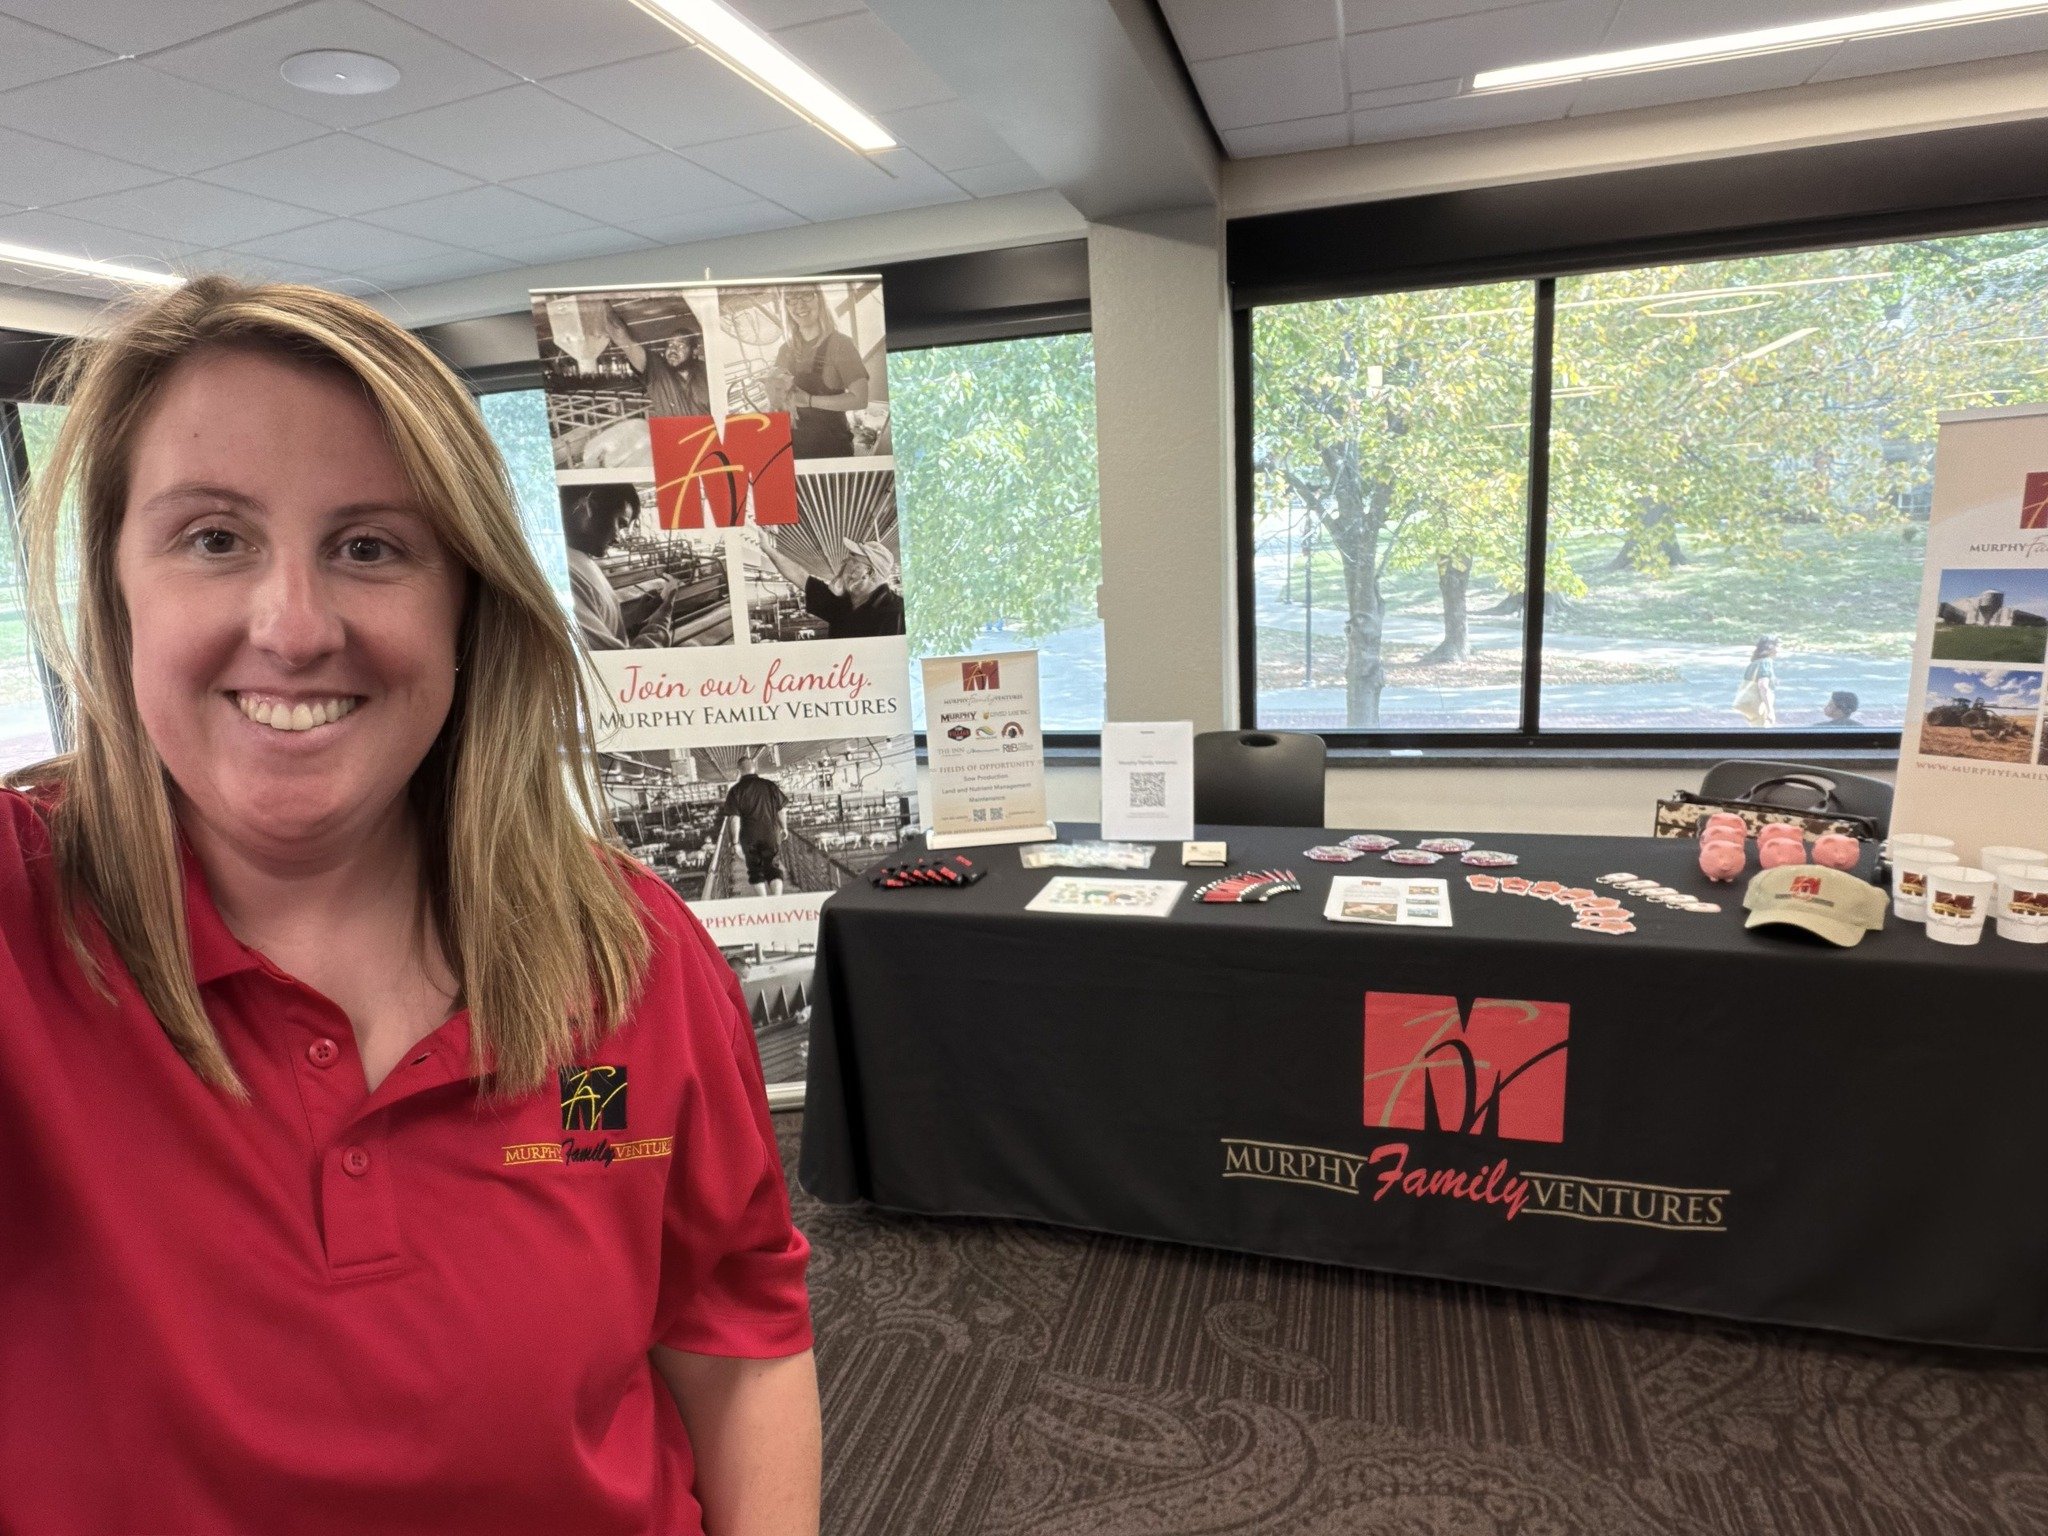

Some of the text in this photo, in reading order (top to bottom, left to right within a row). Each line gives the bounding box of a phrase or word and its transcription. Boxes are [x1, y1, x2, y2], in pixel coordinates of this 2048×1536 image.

[1969, 542, 2025, 552] MURPHY
[620, 654, 872, 704] Join our family.
[599, 697, 897, 729] MURPHY FAMILY VENTURES
[941, 711, 977, 723] MURPHY
[940, 766, 965, 774] FIELDS
[979, 760, 1035, 771] OPPORTUNITY
[1225, 1142, 1725, 1225] MURPHY Family VENTURES
